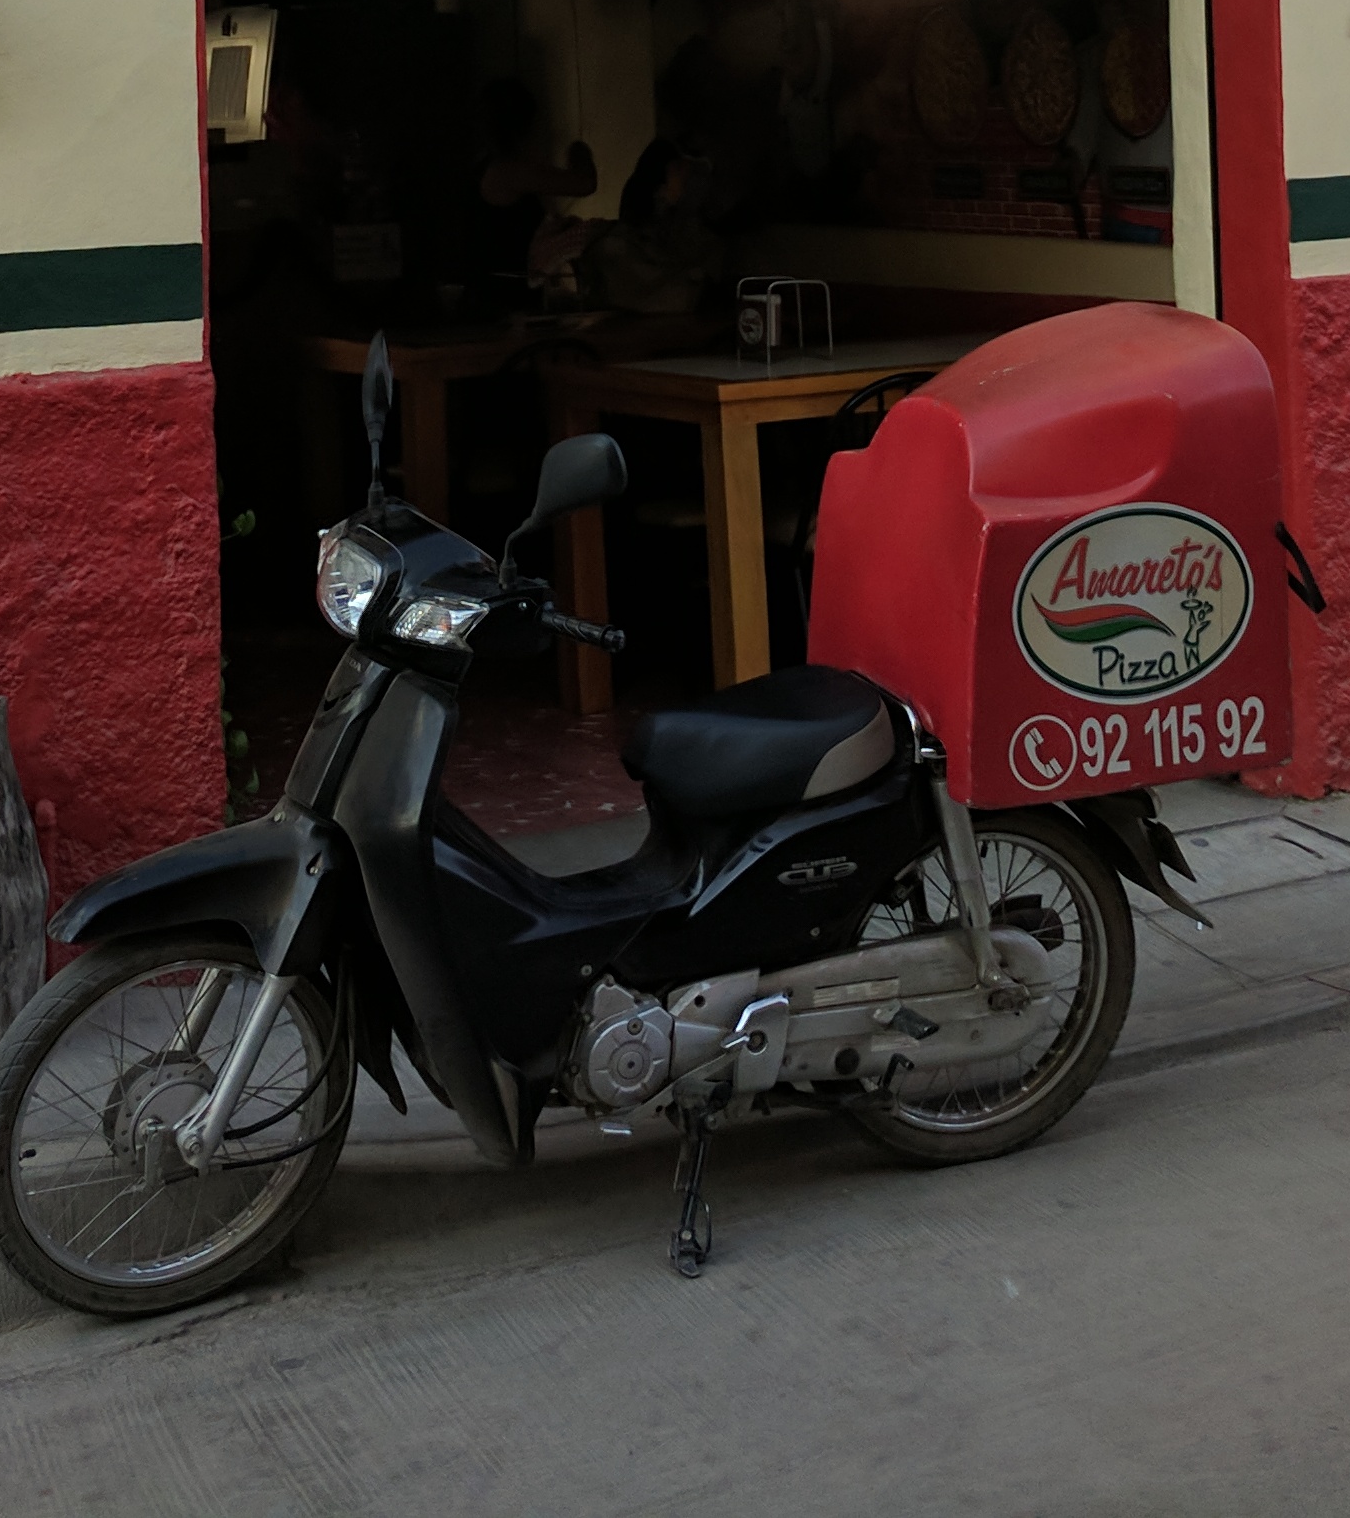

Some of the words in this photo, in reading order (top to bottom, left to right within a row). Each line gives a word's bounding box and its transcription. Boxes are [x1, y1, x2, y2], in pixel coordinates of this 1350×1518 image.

[1049, 536, 1223, 605] Amareto's
[1093, 645, 1179, 687] Pizza
[1080, 713, 1131, 778] 92
[1144, 704, 1206, 768] 115
[1217, 695, 1267, 759] 92
[777, 861, 858, 885] CUB
